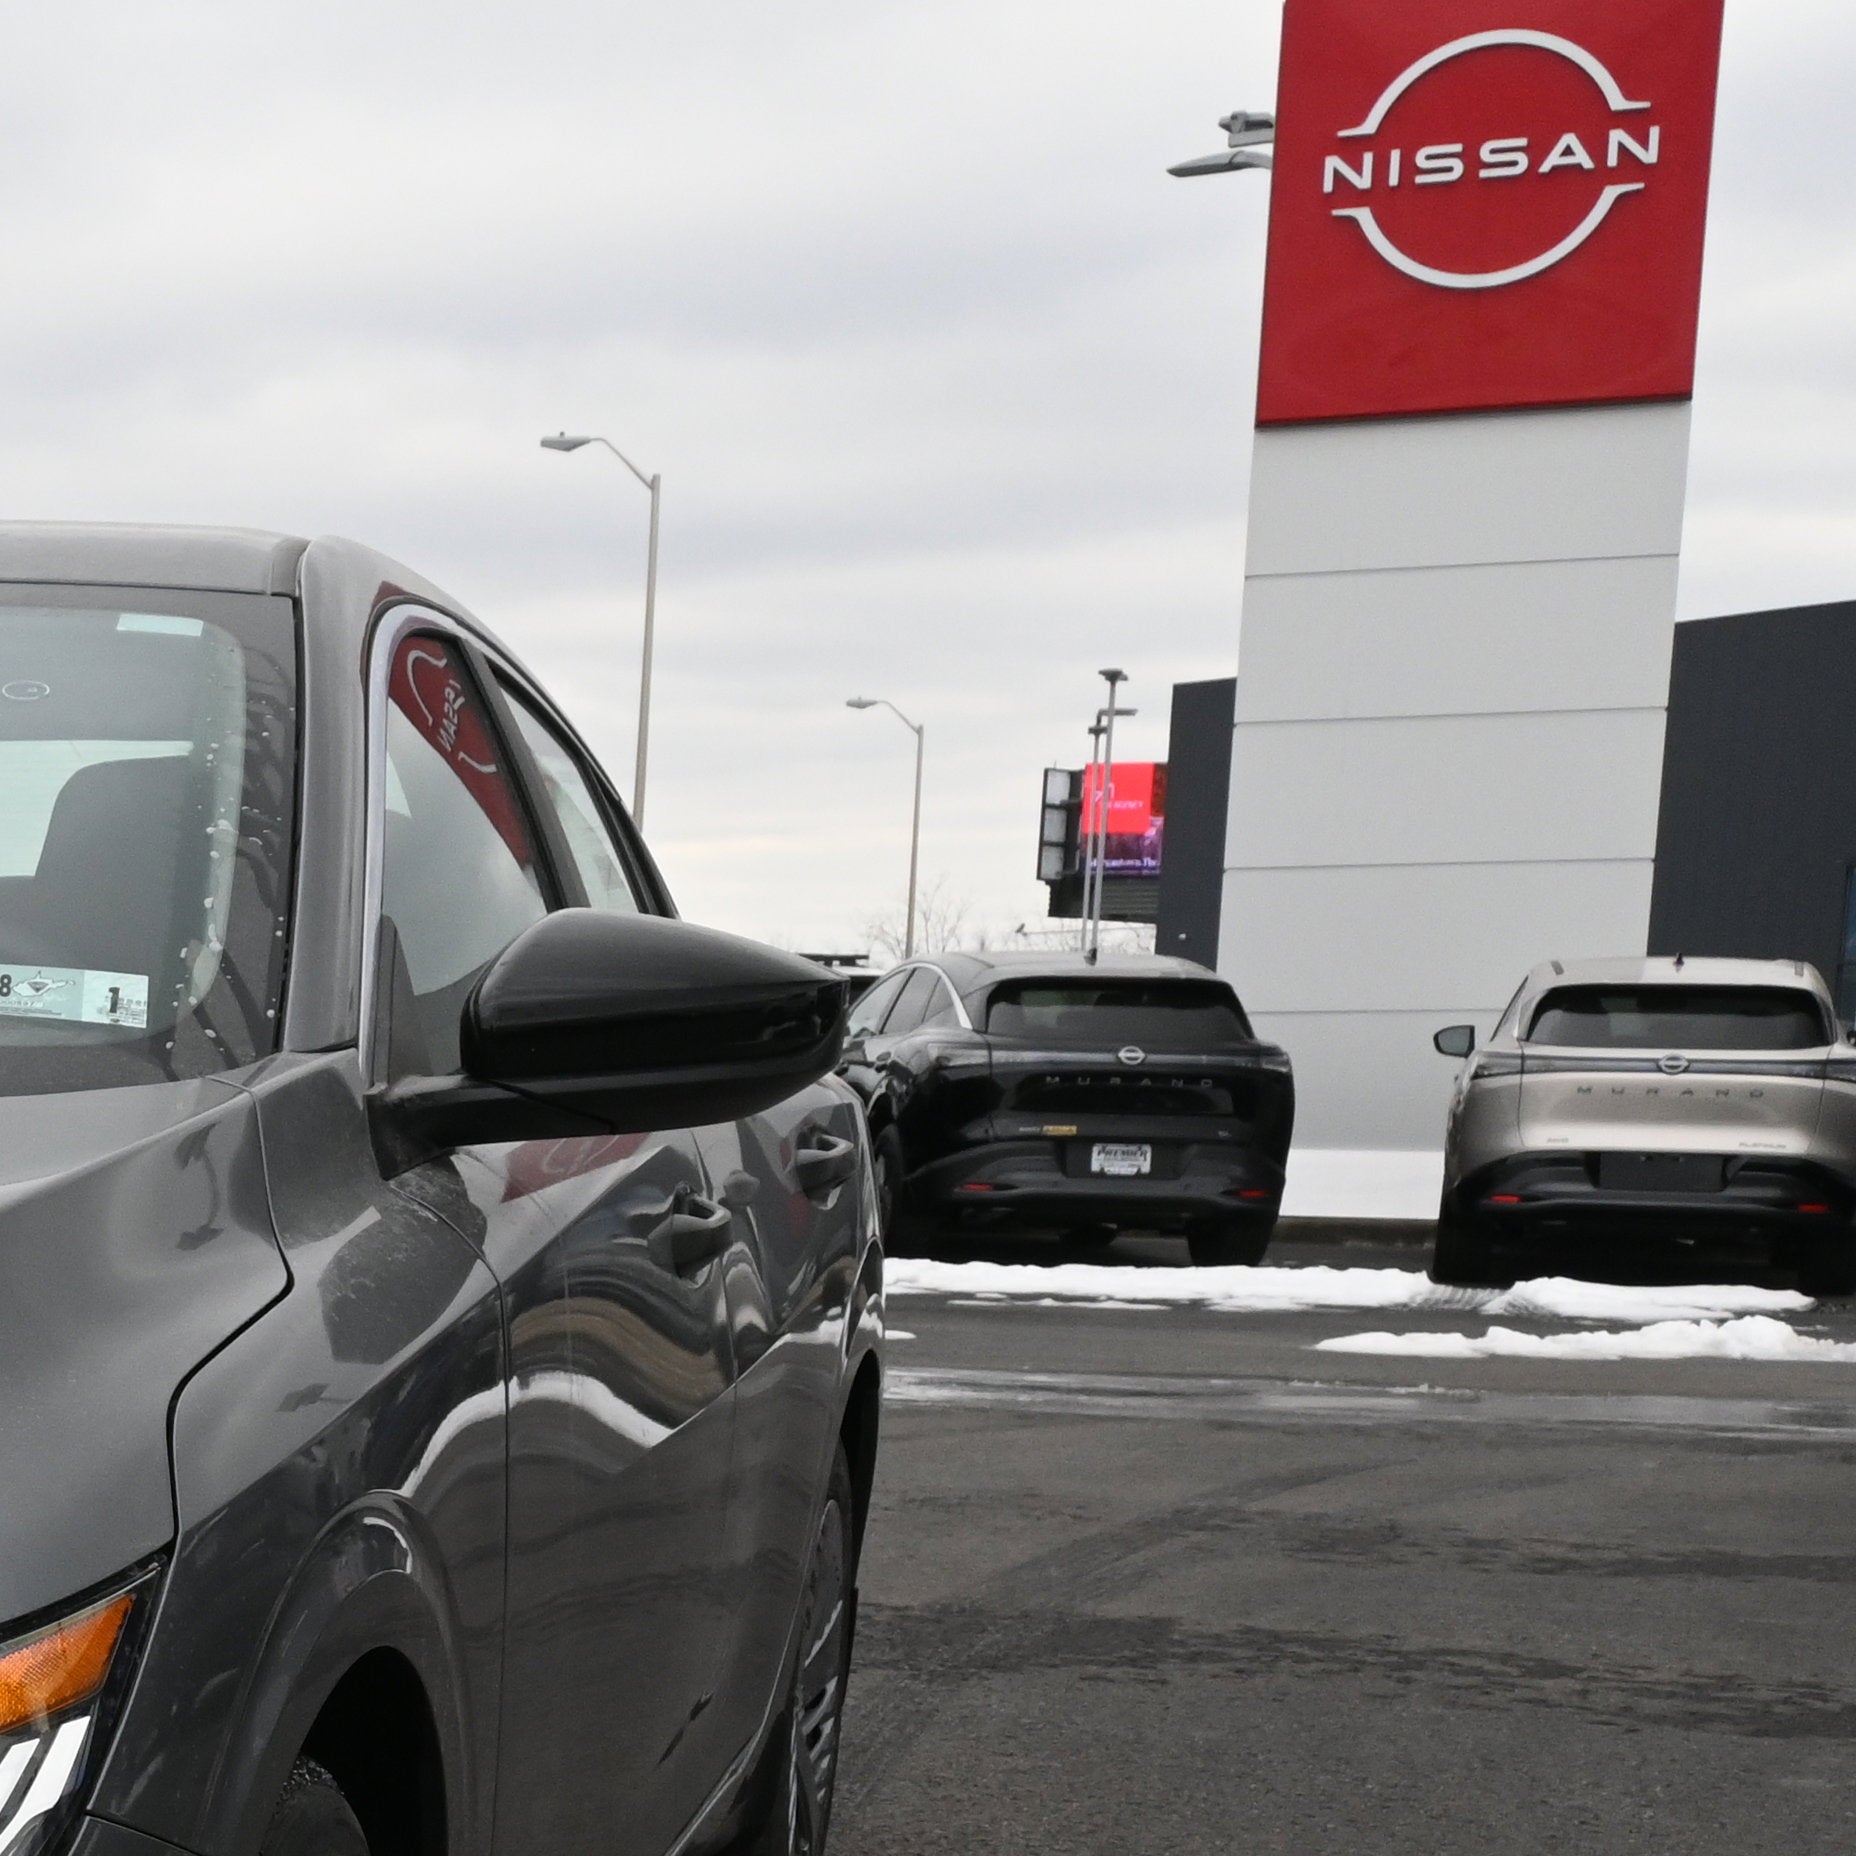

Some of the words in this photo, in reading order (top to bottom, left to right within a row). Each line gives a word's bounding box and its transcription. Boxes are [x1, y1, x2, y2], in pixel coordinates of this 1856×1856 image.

[1323, 126, 1660, 194] NISSAN
[107, 986, 121, 1014] 1
[1045, 1075, 1214, 1088] MURANO
[1576, 1085, 1765, 1099] MURANO
